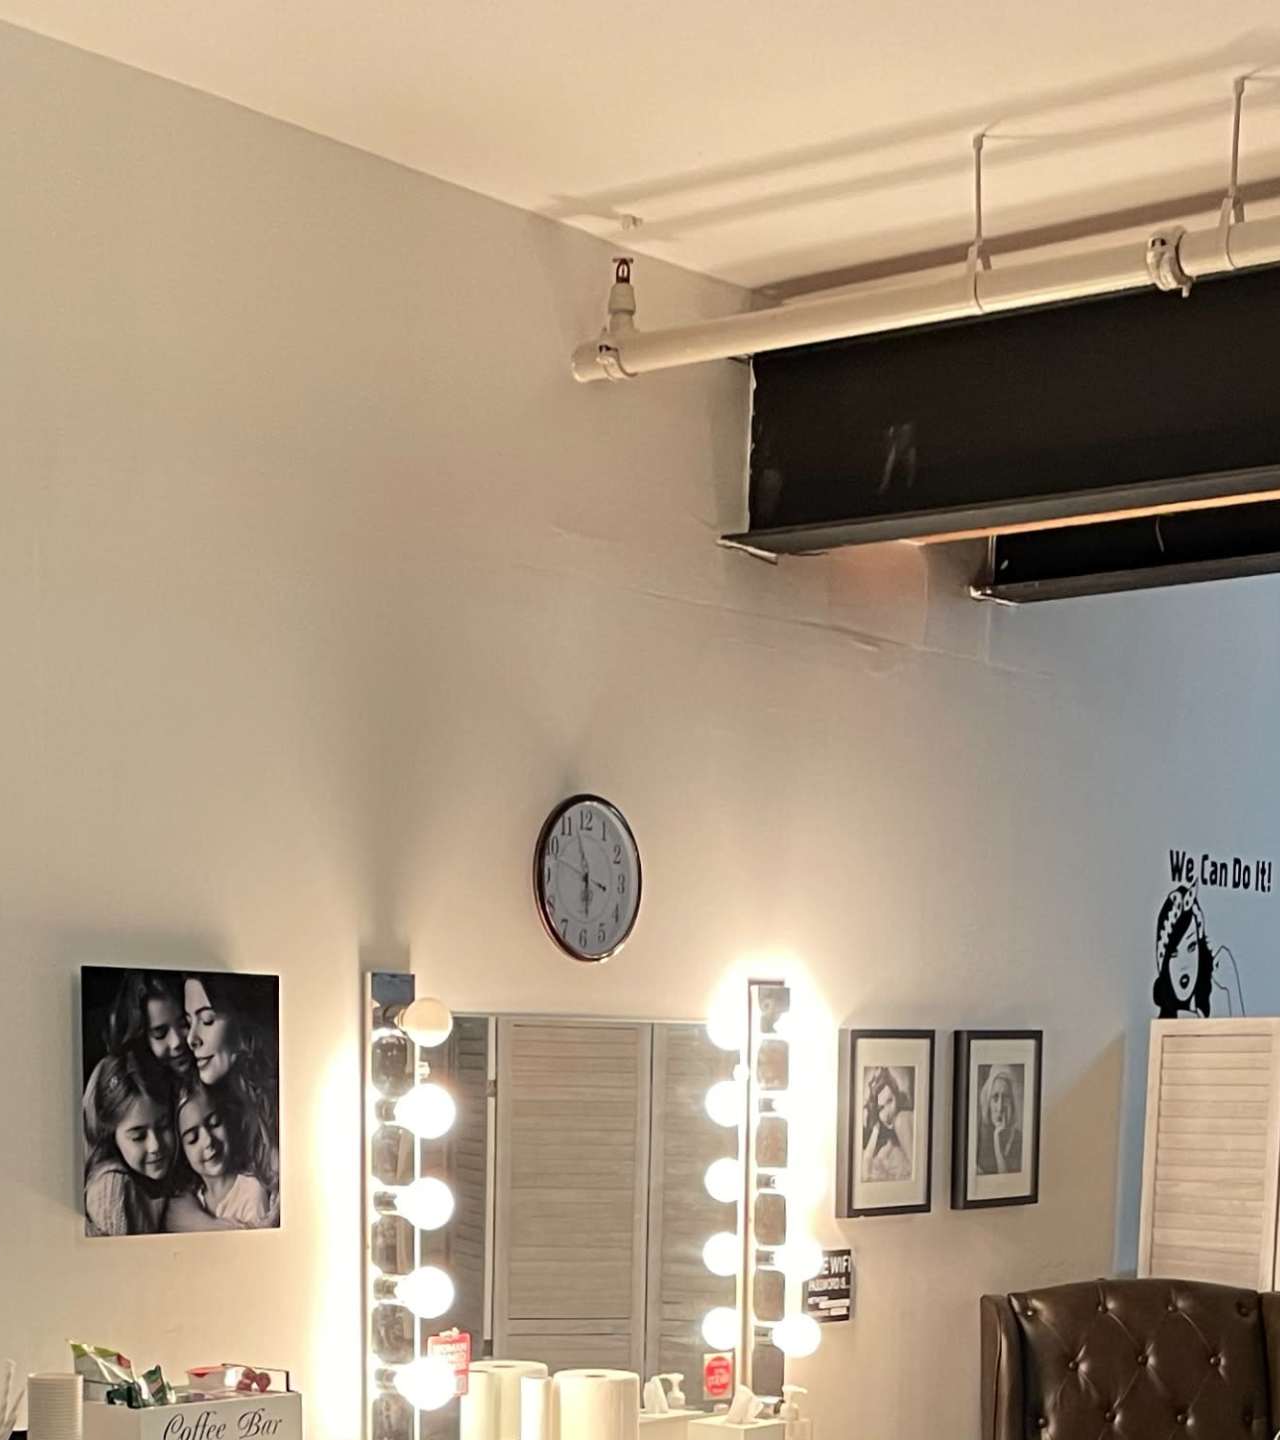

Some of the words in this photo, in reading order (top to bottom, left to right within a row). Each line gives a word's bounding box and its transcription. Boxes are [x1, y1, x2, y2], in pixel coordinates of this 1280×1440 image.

[560, 815, 572, 836] 11
[580, 809, 593, 831] 12
[602, 821, 607, 841] 1
[613, 845, 622, 864] 2
[1169, 849, 1194, 882] We
[1200, 854, 1228, 887] Can
[1232, 857, 1251, 889] Do
[1255, 860, 1272, 892] It!
[617, 873, 625, 894] 3
[560, 919, 569, 940] 7
[579, 928, 588, 948] 6
[597, 923, 606, 943] 5
[237, 1407, 283, 1440] Bar
